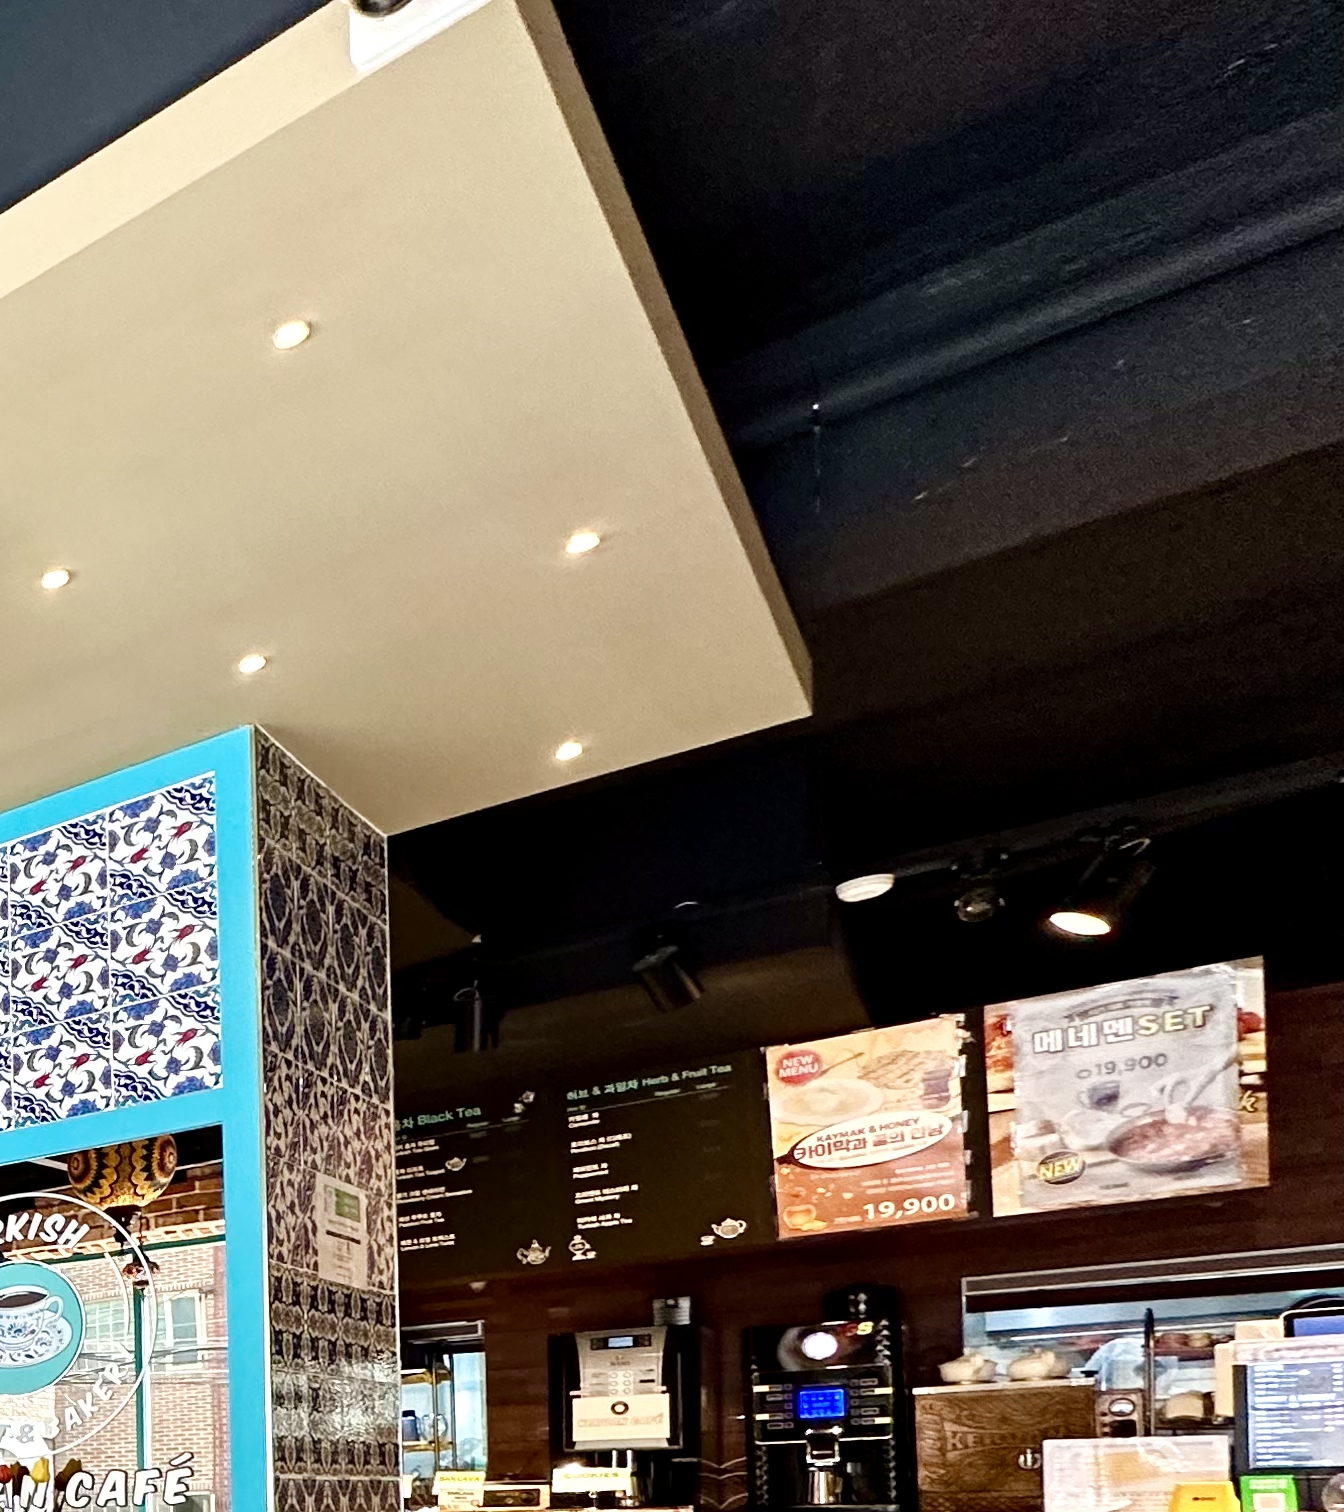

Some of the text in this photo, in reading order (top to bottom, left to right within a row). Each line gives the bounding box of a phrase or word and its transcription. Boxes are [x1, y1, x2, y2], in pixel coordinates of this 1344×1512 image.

[709, 1064, 733, 1075] Tea
[778, 1062, 819, 1079] MENU
[782, 1053, 813, 1068] NEW
[417, 1110, 454, 1126] Black
[456, 1106, 482, 1120] Tea
[816, 1116, 921, 1143] KAYMAK & HONEY
[1038, 1159, 1085, 1181] NEW
[863, 1193, 956, 1221] 19,900
[15, 1423, 35, 1444] &
[65, 1452, 194, 1509] CAFÉ
